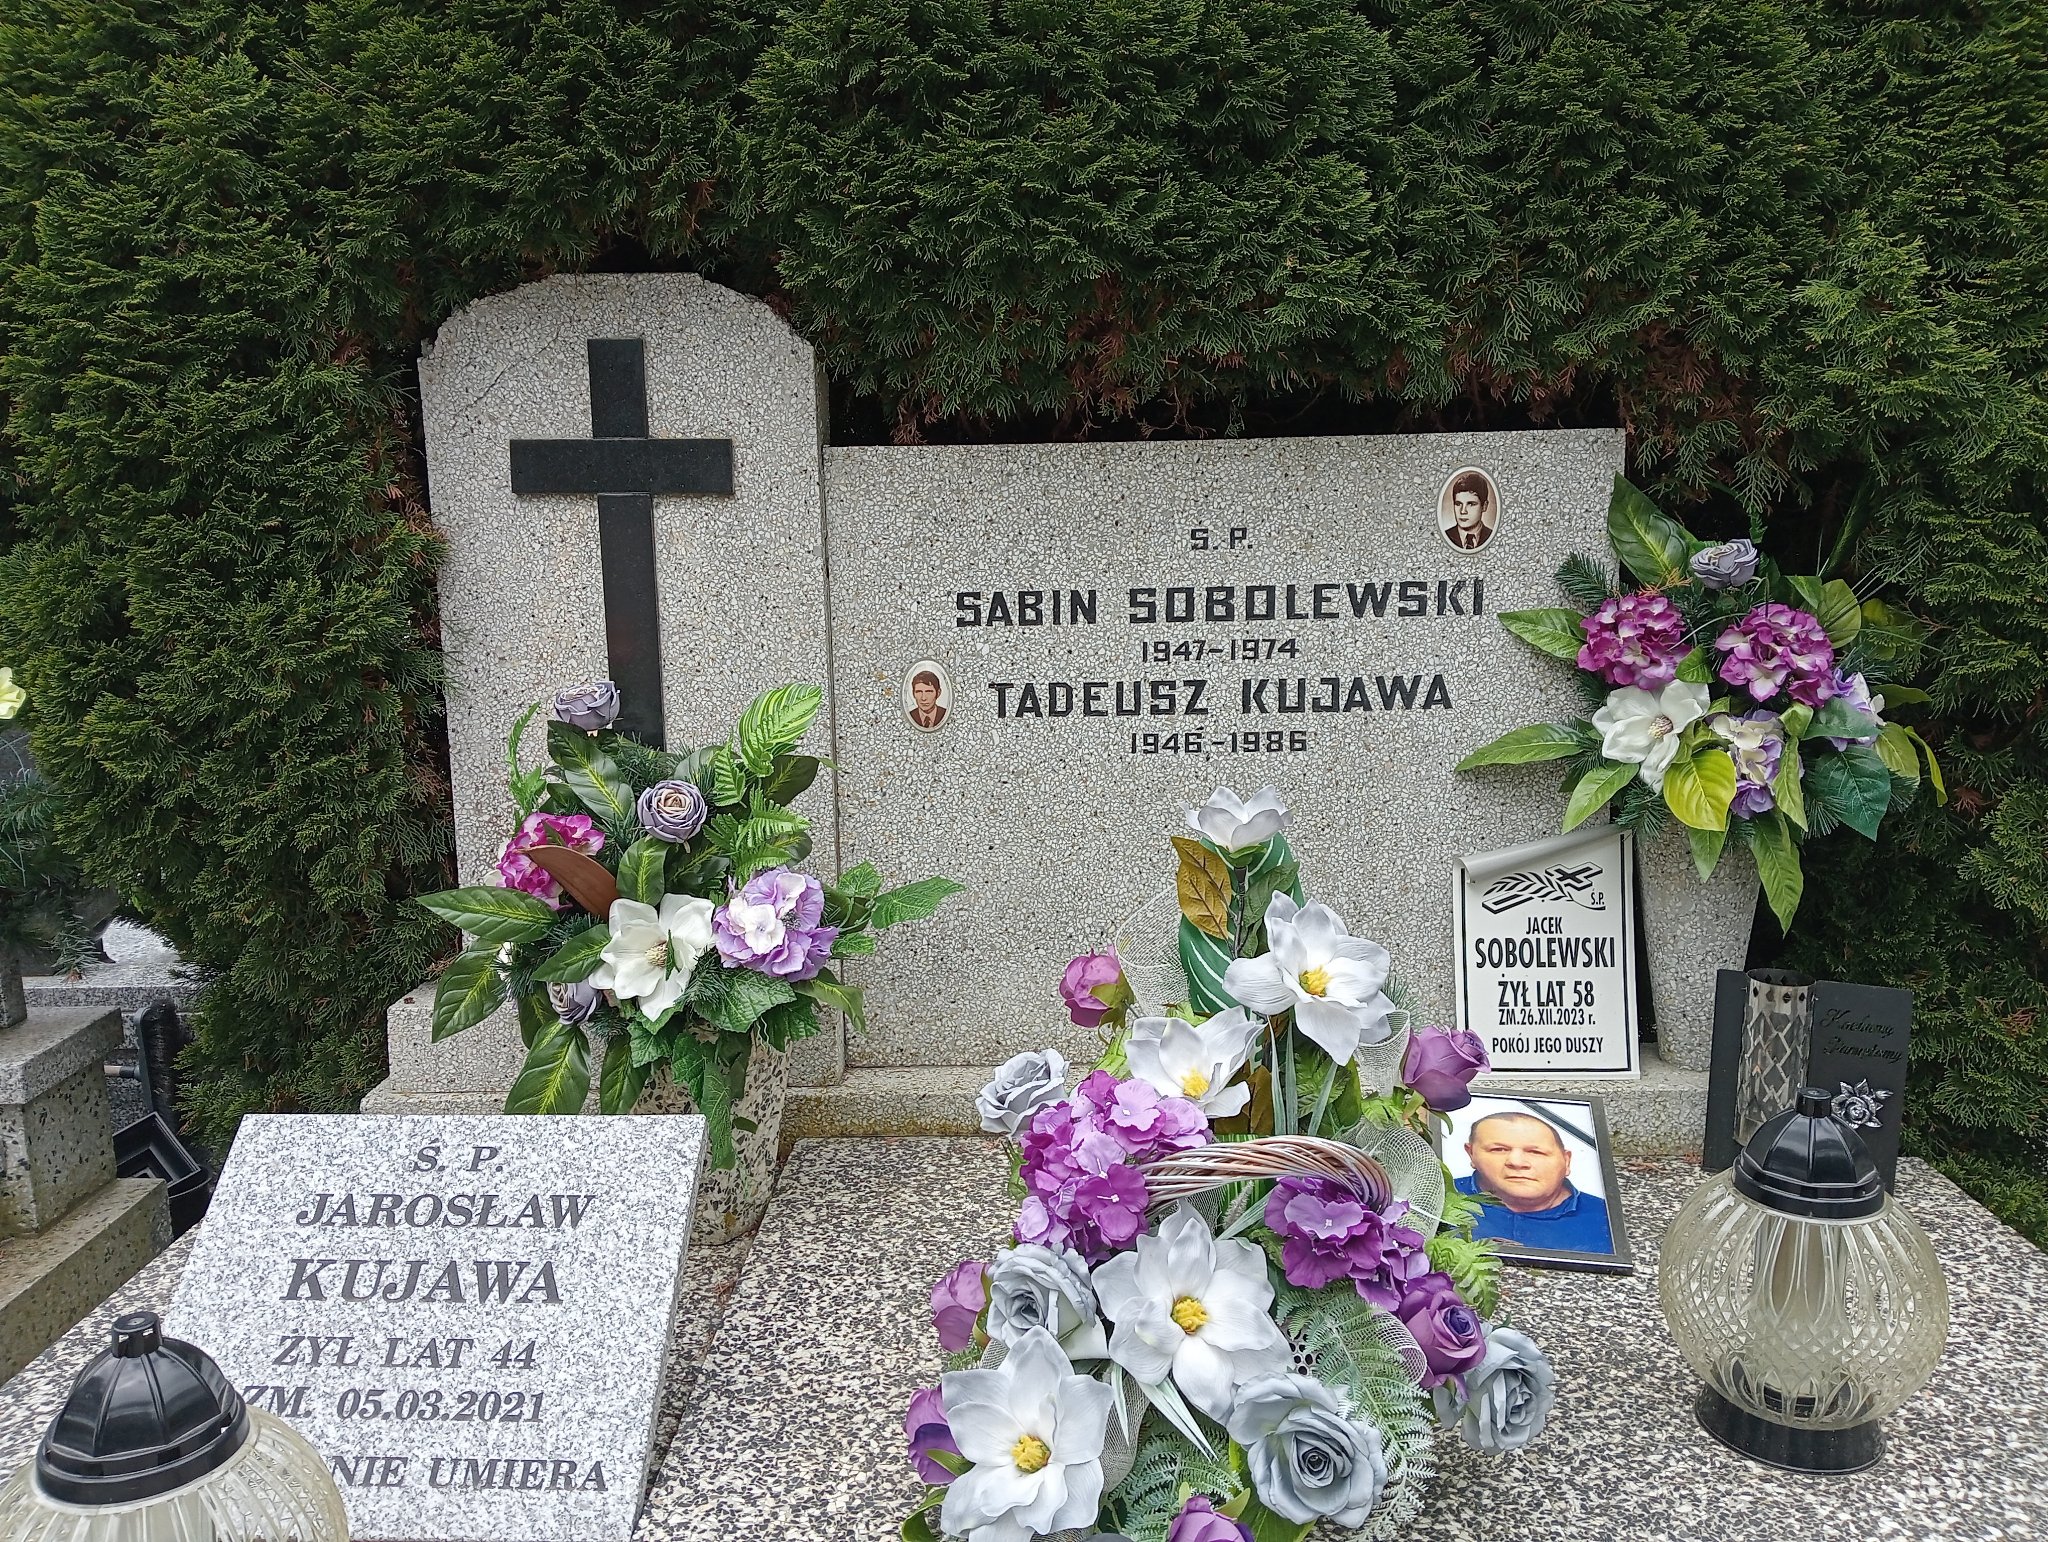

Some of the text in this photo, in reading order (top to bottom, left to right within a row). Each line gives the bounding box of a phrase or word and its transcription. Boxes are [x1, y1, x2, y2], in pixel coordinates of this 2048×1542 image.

[1229, 527, 1253, 549] P.
[956, 579, 1485, 628] SABIN SOBOLEWSKI
[1142, 638, 1300, 663] 1947-1974
[989, 674, 1453, 718] TADEUSZ KUJAWA
[1131, 731, 1307, 754] 1946-1986
[1591, 888, 1605, 905] Ś.P.
[1526, 917, 1562, 934] JACEK
[1475, 937, 1615, 968] SOBOLEWSKI
[1498, 973, 1594, 1007] ŻYŁ LAT 58
[1499, 1008, 1596, 1025] ZM.26.XII.2023 r.
[1492, 1033, 1603, 1053] POKÓJ JEGO DUSZY
[413, 1141, 503, 1173] Ś. P.
[296, 1194, 595, 1229] JAROSŁAW
[279, 1259, 563, 1301] KUJAWA
[272, 1328, 537, 1370] ŻYŁ LAT 44
[241, 1385, 546, 1423] ZM. 05.03.2021
[331, 1456, 608, 1491] NIE UMIERA
